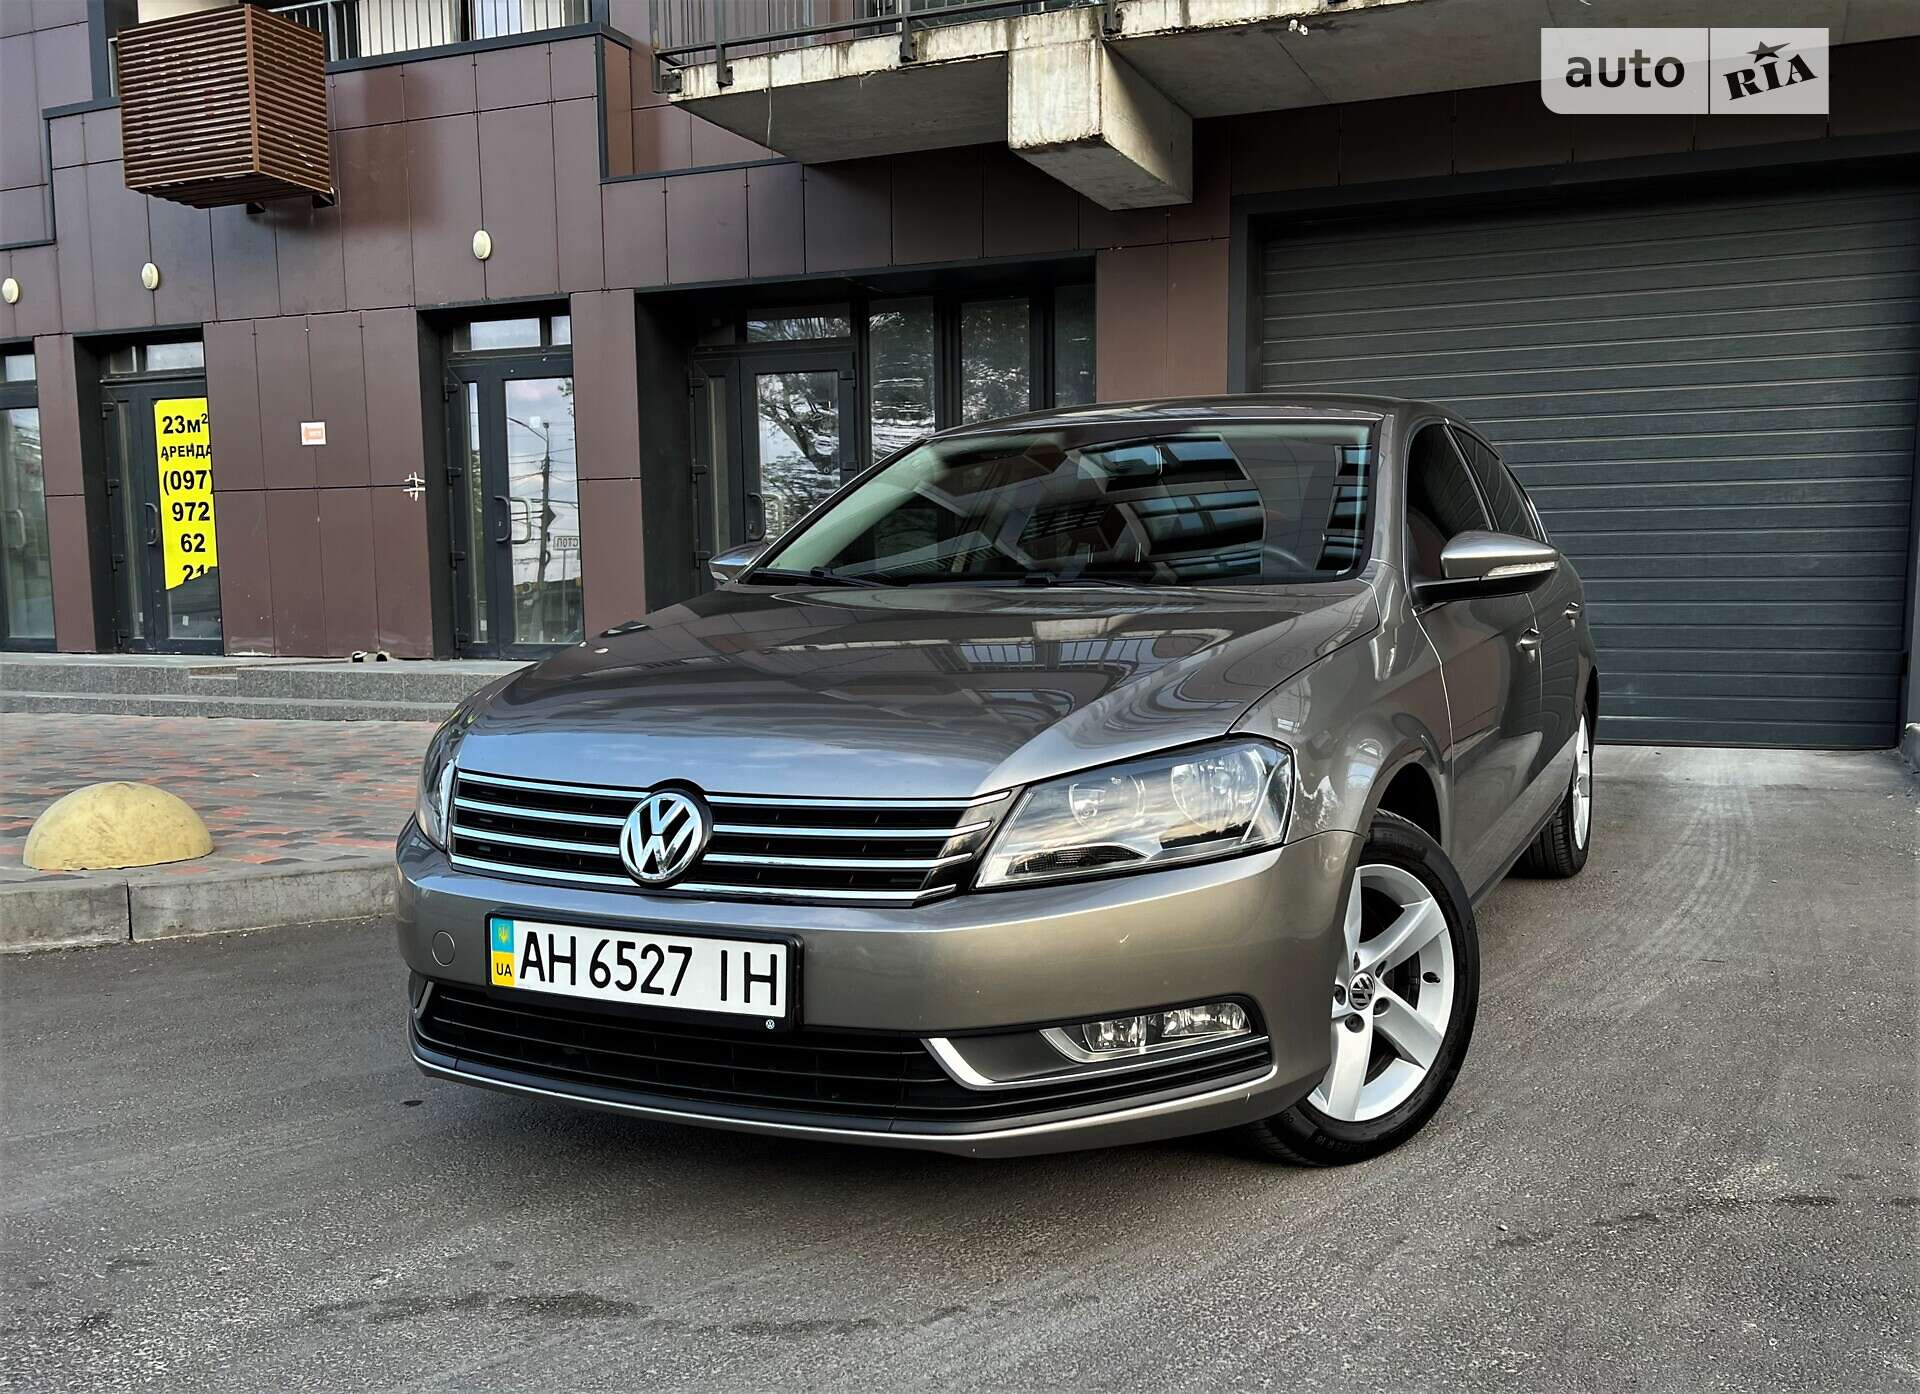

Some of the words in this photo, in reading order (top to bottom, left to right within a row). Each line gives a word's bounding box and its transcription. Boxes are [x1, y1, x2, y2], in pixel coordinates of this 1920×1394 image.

[163, 470, 213, 495] (097)
[172, 501, 211, 522] 972
[180, 533, 206, 553] 62
[495, 962, 513, 977] UA
[519, 931, 577, 986] AH
[588, 939, 693, 997] 6527
[720, 949, 778, 1006] IH
